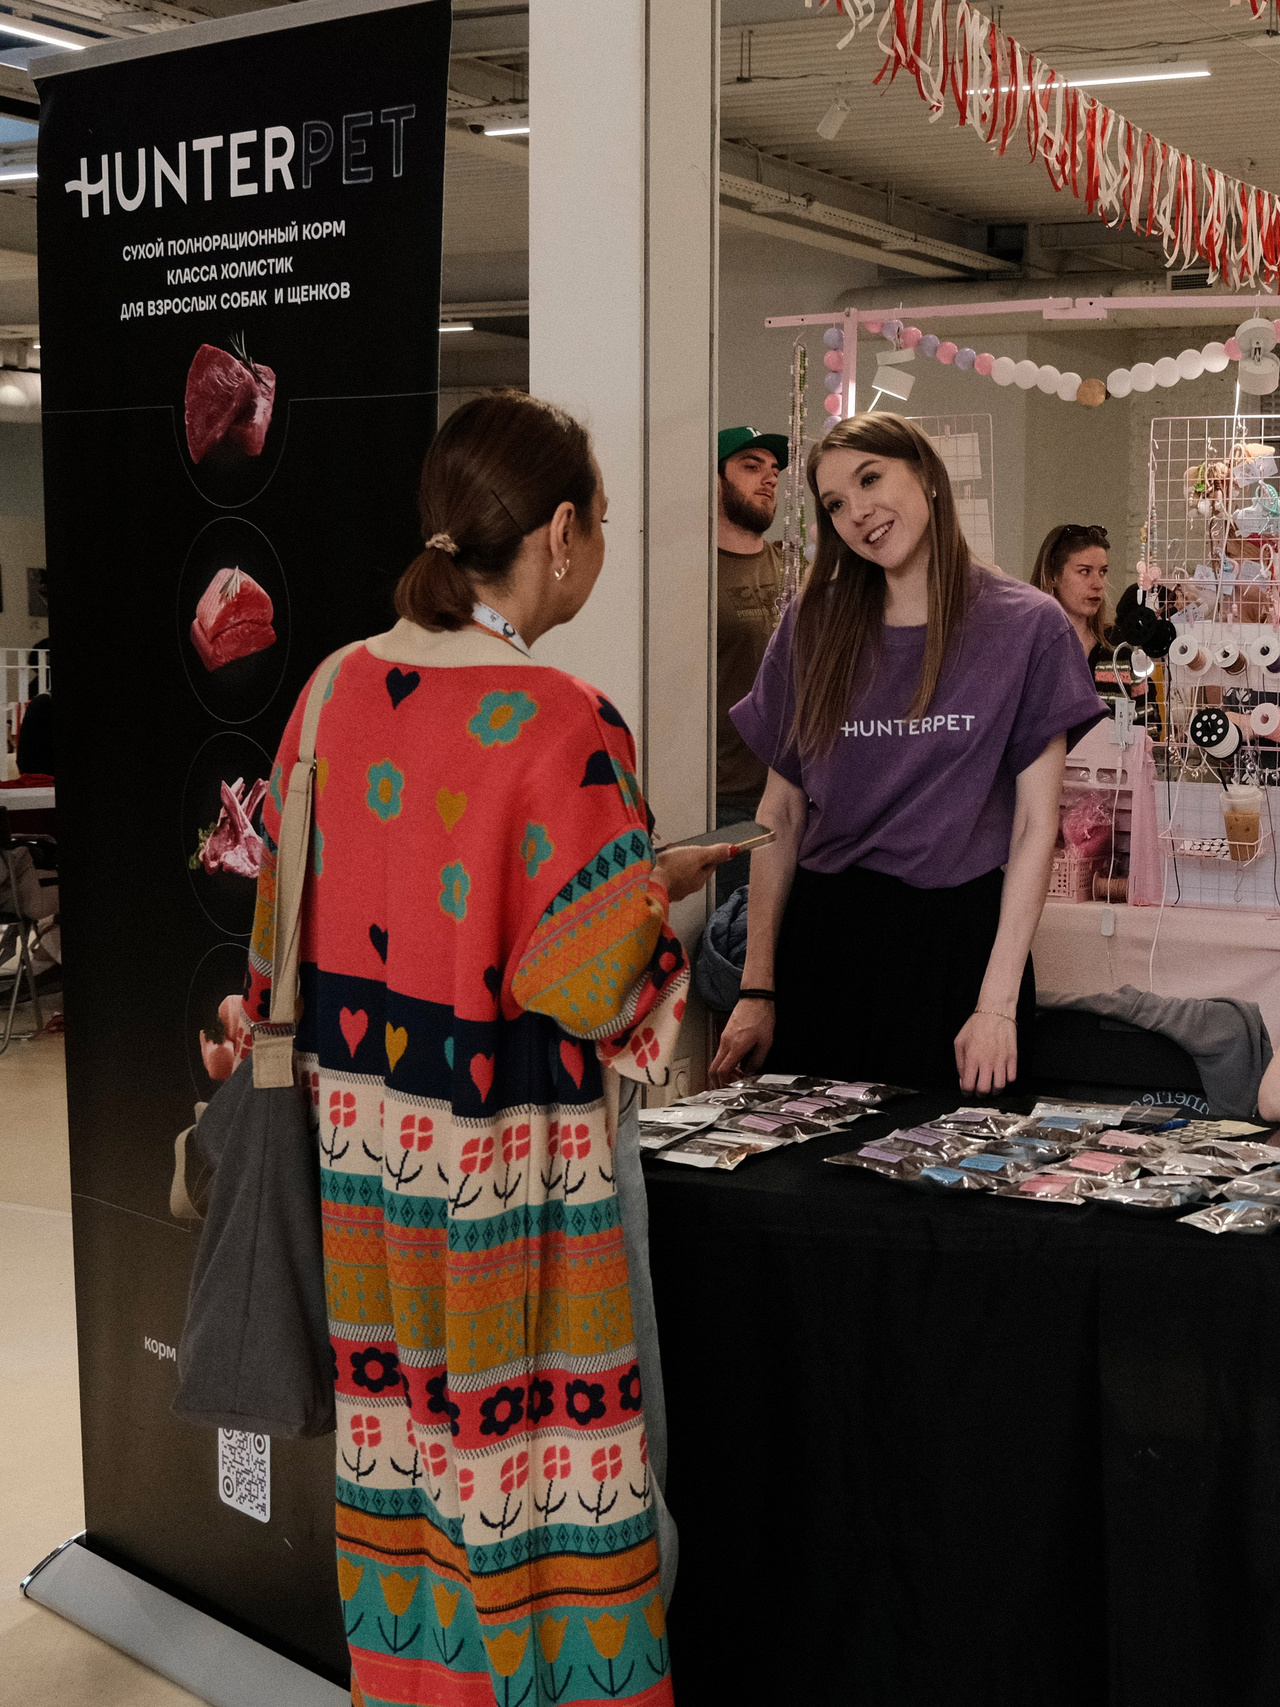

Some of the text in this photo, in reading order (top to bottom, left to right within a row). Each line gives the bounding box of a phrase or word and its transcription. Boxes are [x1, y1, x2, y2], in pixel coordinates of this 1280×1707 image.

[64, 104, 417, 219] HUNTERPET
[122, 219, 346, 262] СУХОЙ ПОЛНОРАЦИОННЫЙ КОРМ
[167, 256, 294, 285] КЛАССА ХОЛИСТИК
[120, 281, 351, 321] ДЛЯ ВЗРОСЛЫХ СОБАК И ЩЕНКОВ
[840, 714, 976, 738] HUNTERPET
[144, 1335, 177, 1362] корм
